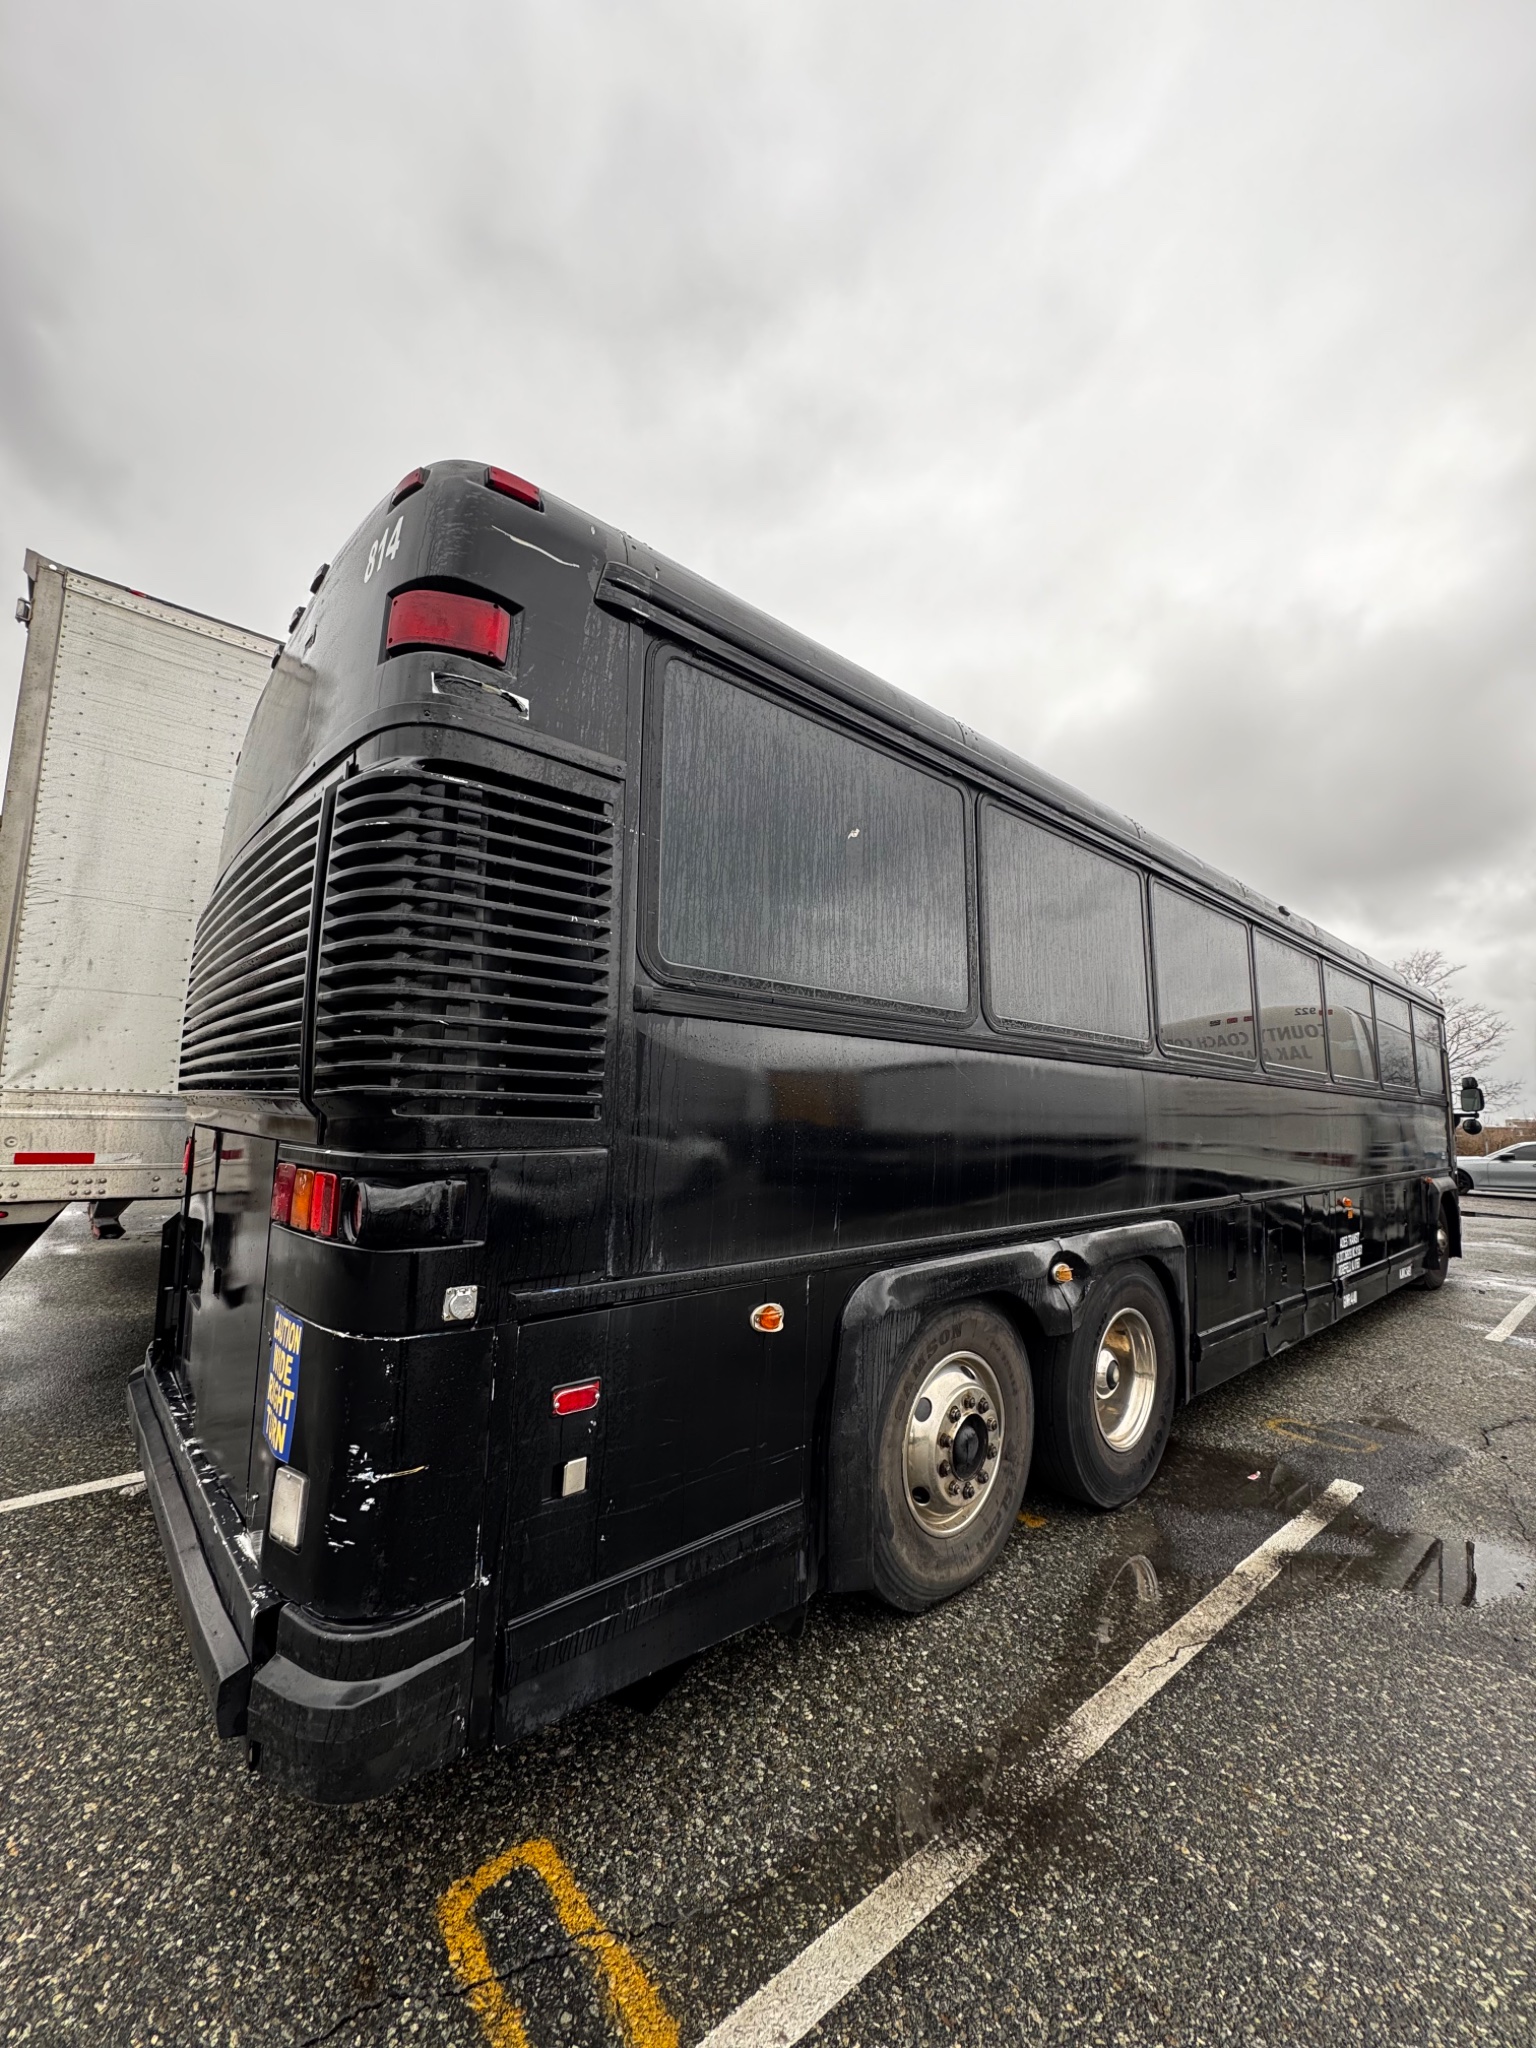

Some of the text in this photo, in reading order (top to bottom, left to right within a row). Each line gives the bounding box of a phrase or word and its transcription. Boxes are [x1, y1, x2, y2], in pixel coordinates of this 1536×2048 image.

[363, 515, 404, 584] 814
[274, 1311, 303, 1355] CAUTION
[273, 1342, 294, 1387] WIDE
[895, 1321, 963, 1420] SAMSON
[267, 1372, 295, 1420] RIGHT
[265, 1404, 287, 1454] TURN
